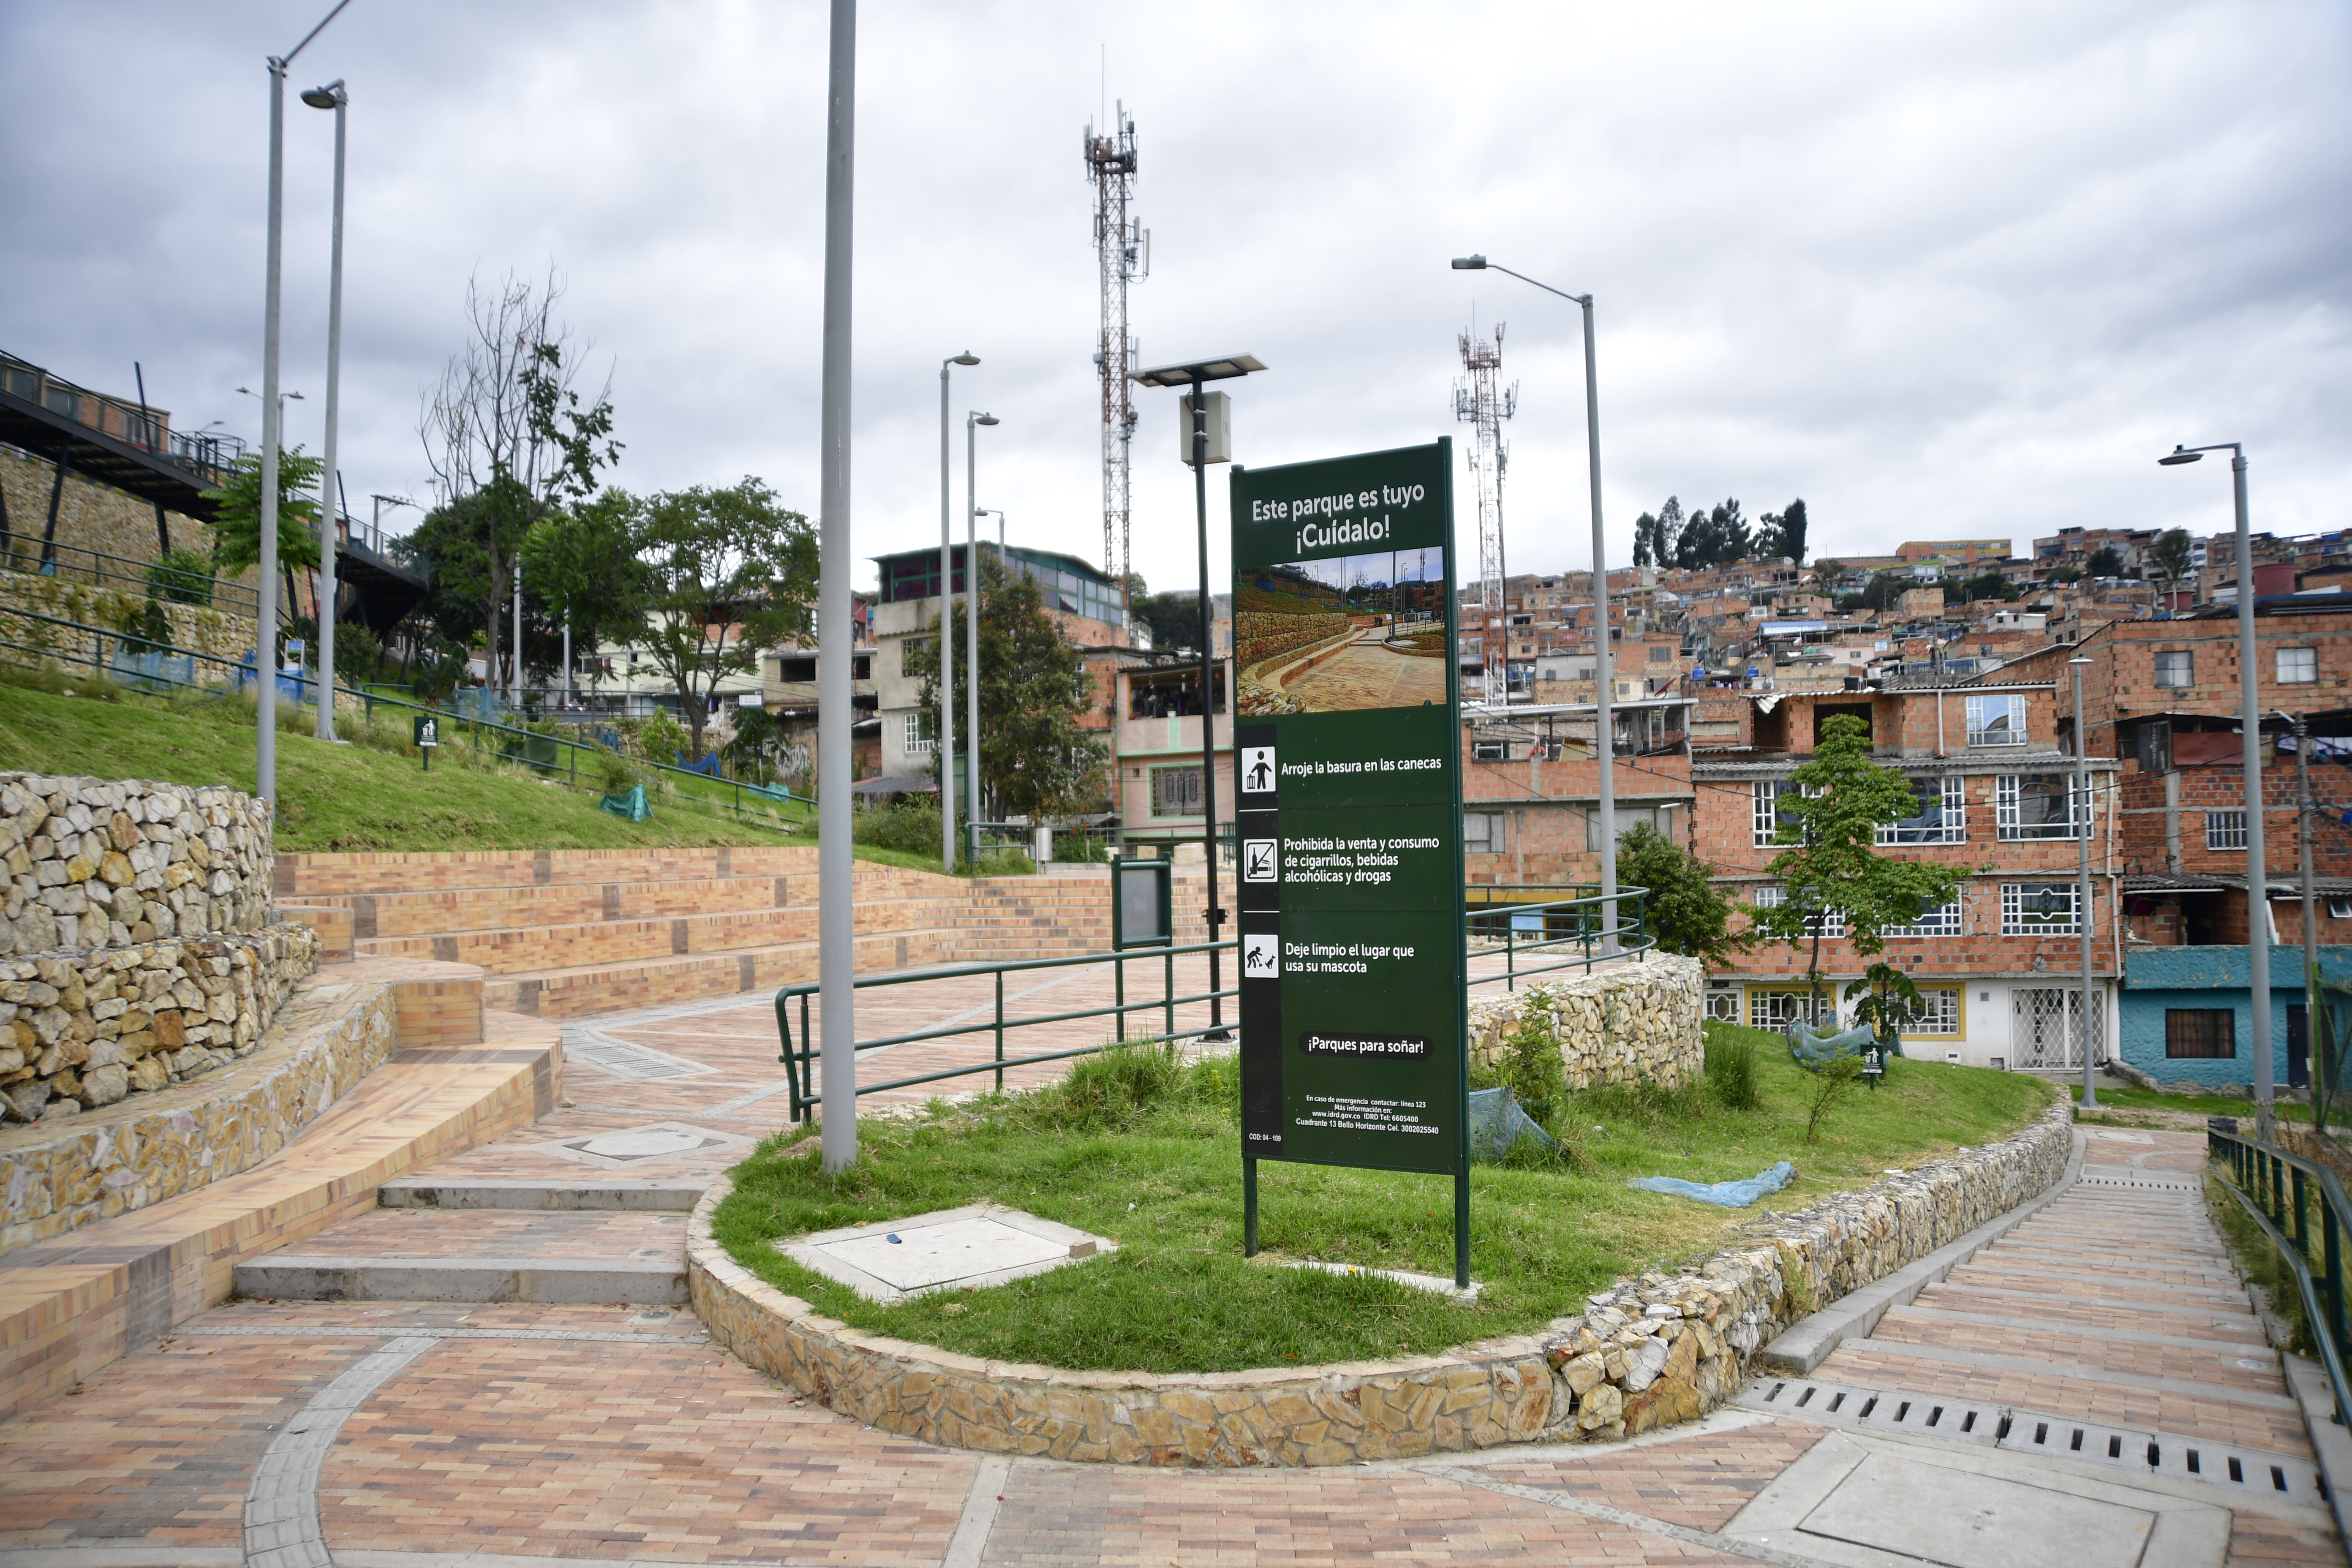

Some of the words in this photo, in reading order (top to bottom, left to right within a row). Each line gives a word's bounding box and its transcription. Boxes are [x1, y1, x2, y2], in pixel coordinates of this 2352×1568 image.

[1253, 500, 1287, 520] Este
[1293, 493, 1354, 521] parque
[1359, 490, 1377, 507] es
[1383, 485, 1424, 508] tuyo
[1296, 514, 1390, 554] ¡Cuídalo!
[1282, 762, 1312, 777] Arroje
[1315, 761, 1324, 773] la
[1327, 761, 1361, 773] basura
[1364, 762, 1377, 771] en
[1381, 758, 1395, 770] las
[1398, 759, 1441, 770] canecas
[1285, 838, 1333, 850] Prohibida
[1337, 837, 1345, 849] la
[1348, 838, 1377, 849] venta
[1380, 839, 1386, 852] y
[1388, 838, 1439, 848] consumo
[1285, 855, 1298, 867] de
[1300, 854, 1354, 869] cigarrillos,
[1357, 853, 1398, 866] bebidas
[1285, 870, 1343, 882] alcohólicas
[1346, 872, 1352, 885] y
[1355, 869, 1391, 885] drogas
[1286, 943, 1309, 958] Deje
[1312, 943, 1346, 958] limpio
[1349, 944, 1358, 956] el
[1362, 944, 1390, 959] lugar
[1393, 947, 1414, 960] que
[1286, 962, 1303, 971] usa
[1307, 963, 1318, 972] su
[1321, 961, 1367, 972] mascota
[1309, 1037, 1356, 1053] ¡Parques
[1360, 1042, 1384, 1054] para
[1388, 1040, 1423, 1053] soñar!
[1312, 1111, 1360, 1119] www.idrd.gov.co
[1296, 1118, 1327, 1126] Cuadrante
[1356, 1122, 1386, 1130] Horizonte
[1402, 1125, 1438, 1134] 3002025540
